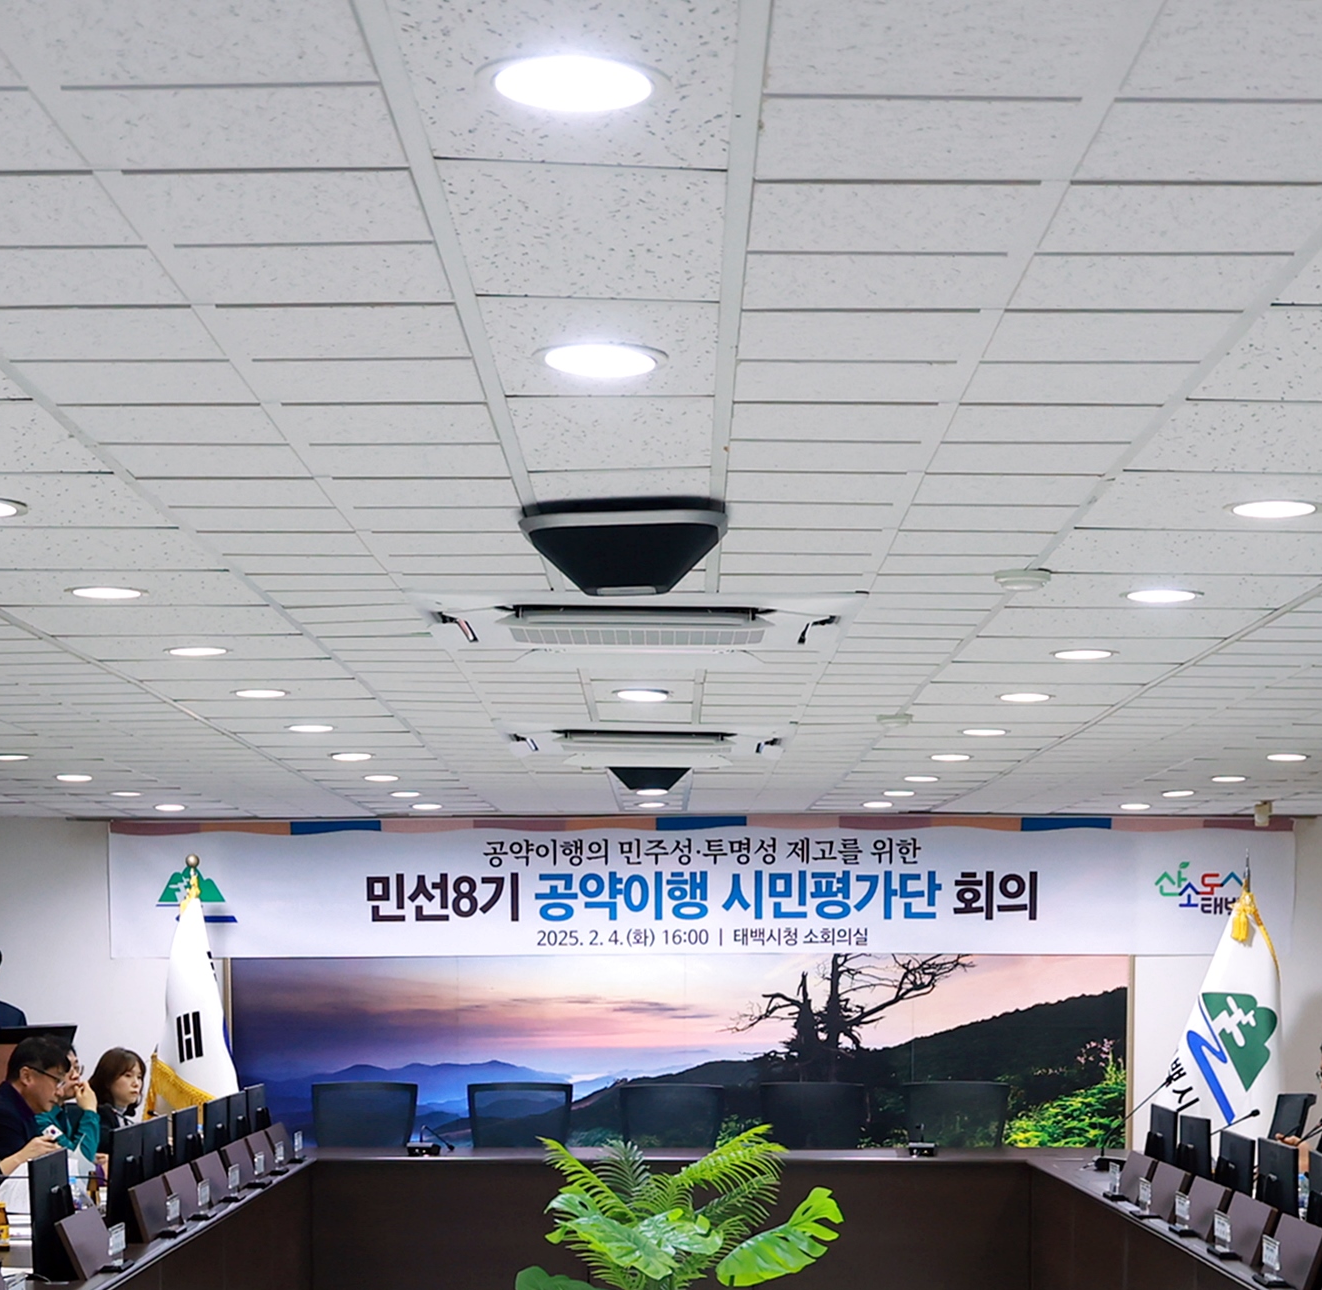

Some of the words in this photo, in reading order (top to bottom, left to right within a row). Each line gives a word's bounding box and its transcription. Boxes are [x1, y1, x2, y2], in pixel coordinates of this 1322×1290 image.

[483, 838, 608, 868] 공약이행의
[618, 837, 776, 865] 민주성·투명성
[786, 837, 863, 865] 제고를
[870, 837, 921, 865] 위한
[366, 872, 519, 922] 민선8기
[535, 871, 709, 922] 공약이행
[722, 870, 942, 920] 시민평가단
[953, 870, 1038, 920] 회의
[537, 930, 583, 946] 2025.
[589, 930, 603, 946] 2.
[663, 929, 709, 946] 16:00
[734, 927, 797, 946] 태백시청
[803, 927, 868, 946] 소회의실
